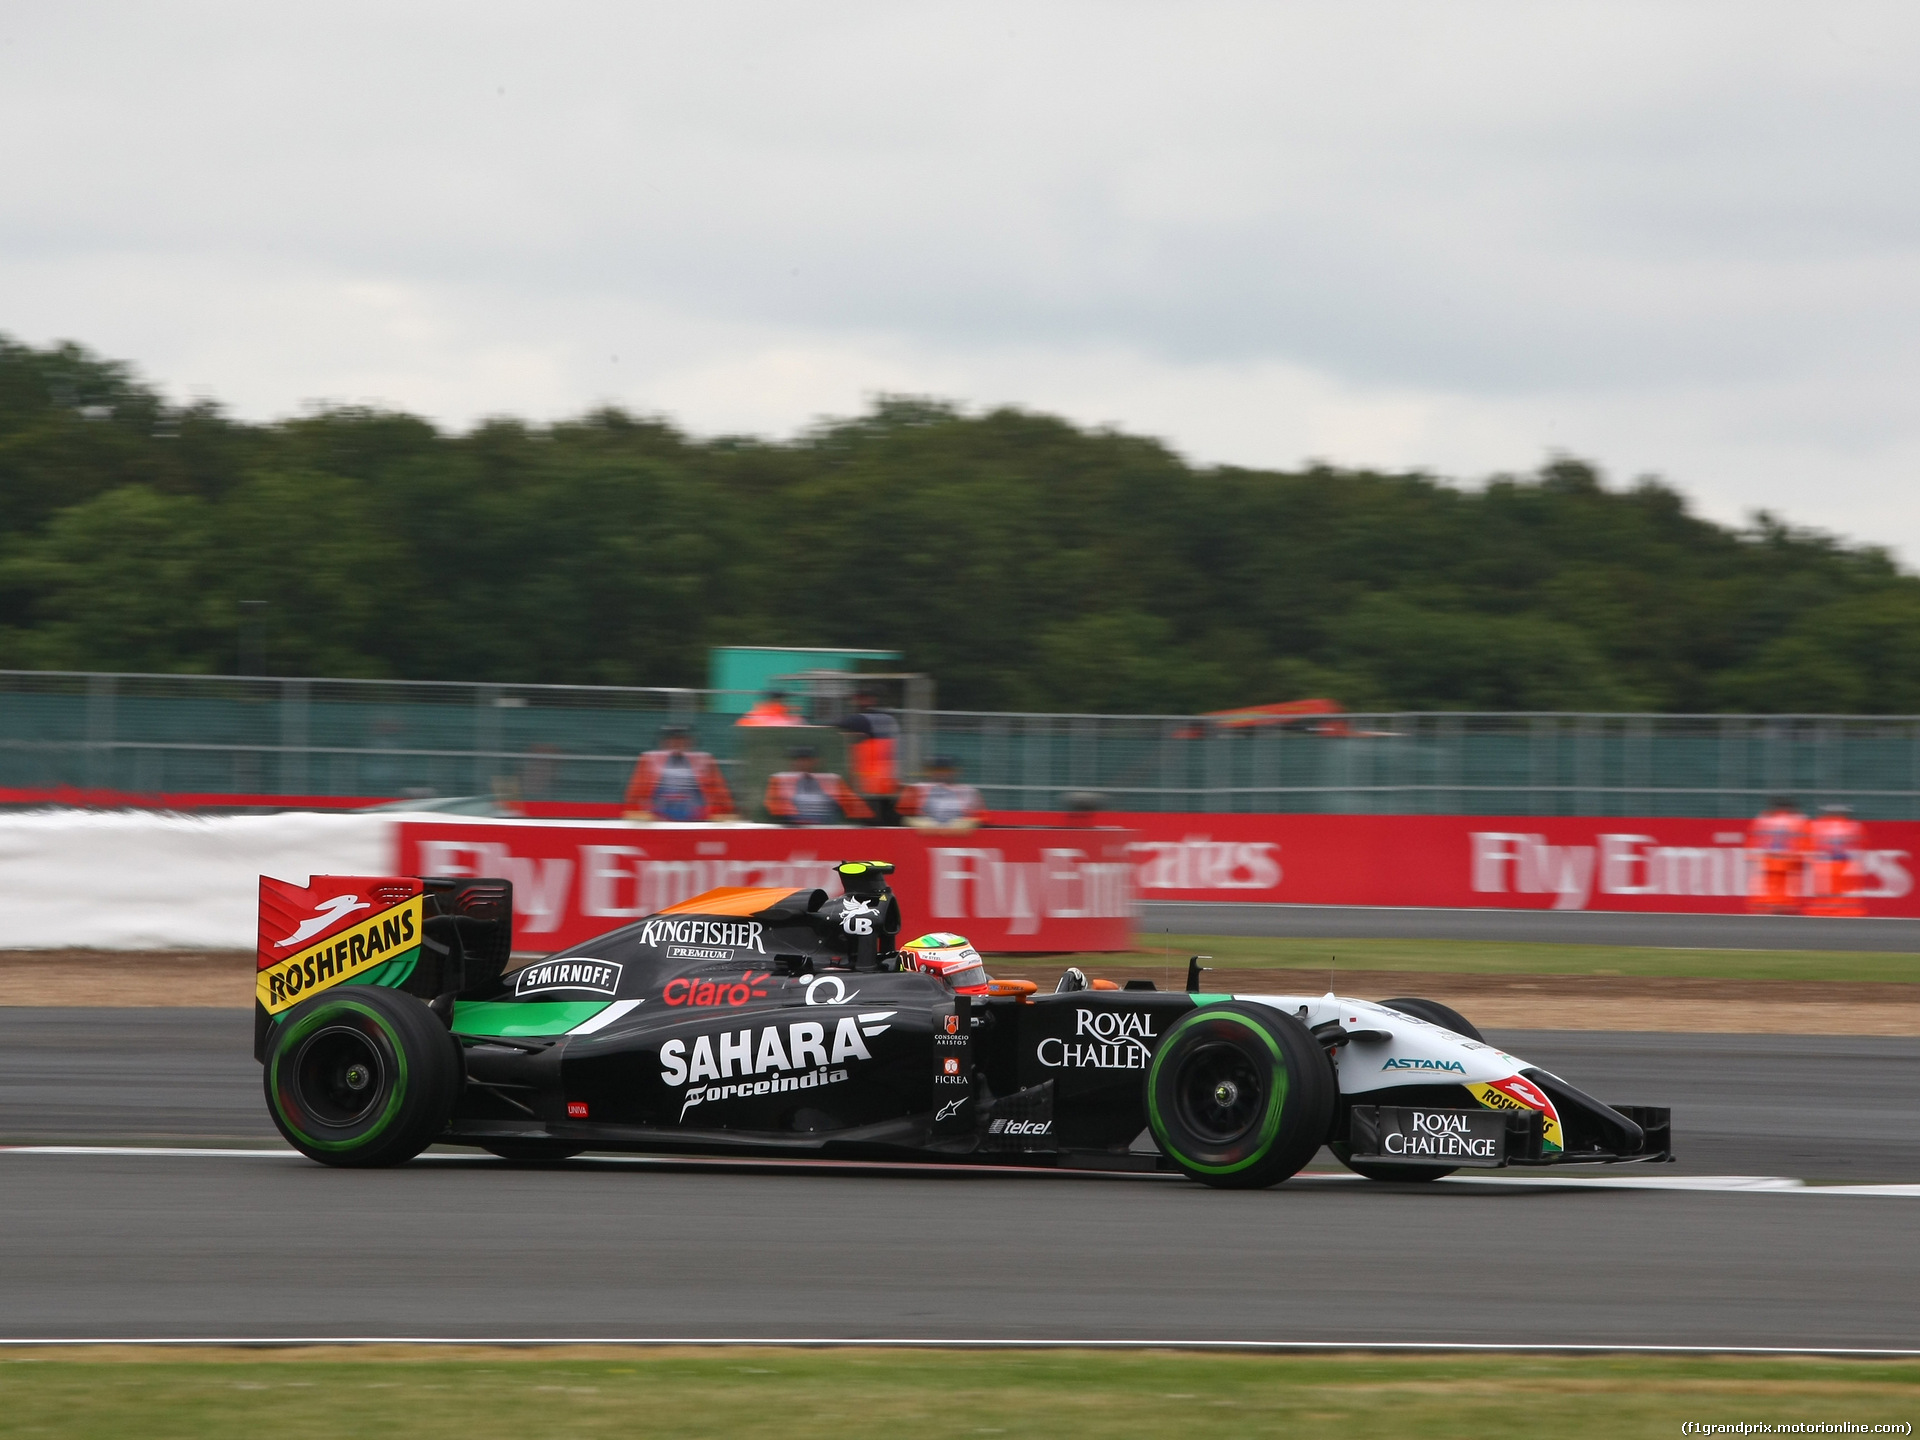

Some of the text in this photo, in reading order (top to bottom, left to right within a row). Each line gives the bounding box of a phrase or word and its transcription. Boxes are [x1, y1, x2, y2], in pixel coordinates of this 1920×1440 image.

[1470, 832, 1914, 910] Fly Emis
[639, 919, 767, 955] KINGFISHER
[269, 909, 415, 1006] ROSHFRANS
[672, 947, 727, 960] PREMIUM
[662, 977, 752, 1008] Claro
[1075, 1008, 1158, 1045] ROYAL
[660, 1017, 872, 1087] SAHARA
[1036, 1036, 1152, 1069] CHALLEN
[1381, 1057, 1467, 1075] ASTANA
[935, 1075, 969, 1085] FICREA
[1003, 1119, 1053, 1135] telcel
[1412, 1112, 1471, 1138] ROYAL
[1384, 1130, 1496, 1156] CHALLENGE
